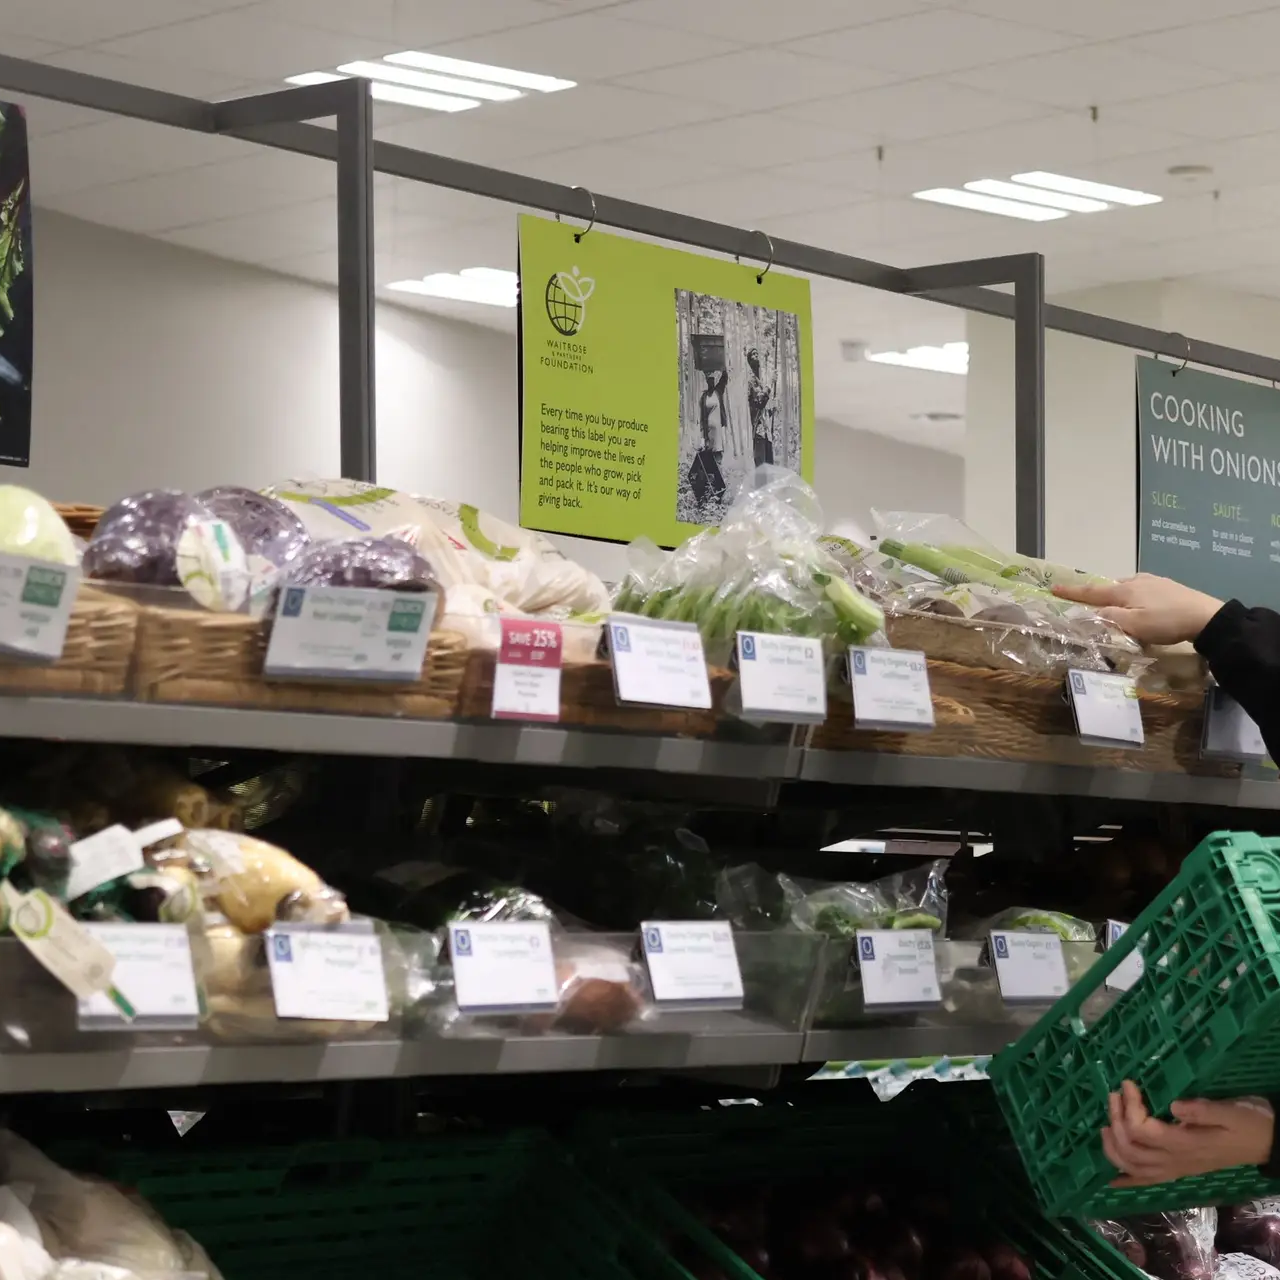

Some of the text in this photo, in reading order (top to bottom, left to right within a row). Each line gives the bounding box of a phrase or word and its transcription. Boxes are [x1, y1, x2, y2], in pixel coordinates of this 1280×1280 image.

[546, 339, 588, 354] WAITROSE
[540, 356, 594, 374] FOUNDATION
[541, 402, 649, 432] Every time you buy produce
[1150, 391, 1245, 438] COOKING
[540, 420, 637, 448] bearing this label you are
[540, 438, 646, 466] helping improve the lives of
[1150, 434, 1204, 472] WITH
[540, 457, 553, 469] the
[555, 461, 582, 475] people
[585, 464, 601, 477] who
[626, 470, 642, 484] pick
[538, 492, 583, 509] giving back.
[539, 475, 641, 502] and pack it. It's our way of
[507, 628, 558, 649] SAVE 25%
